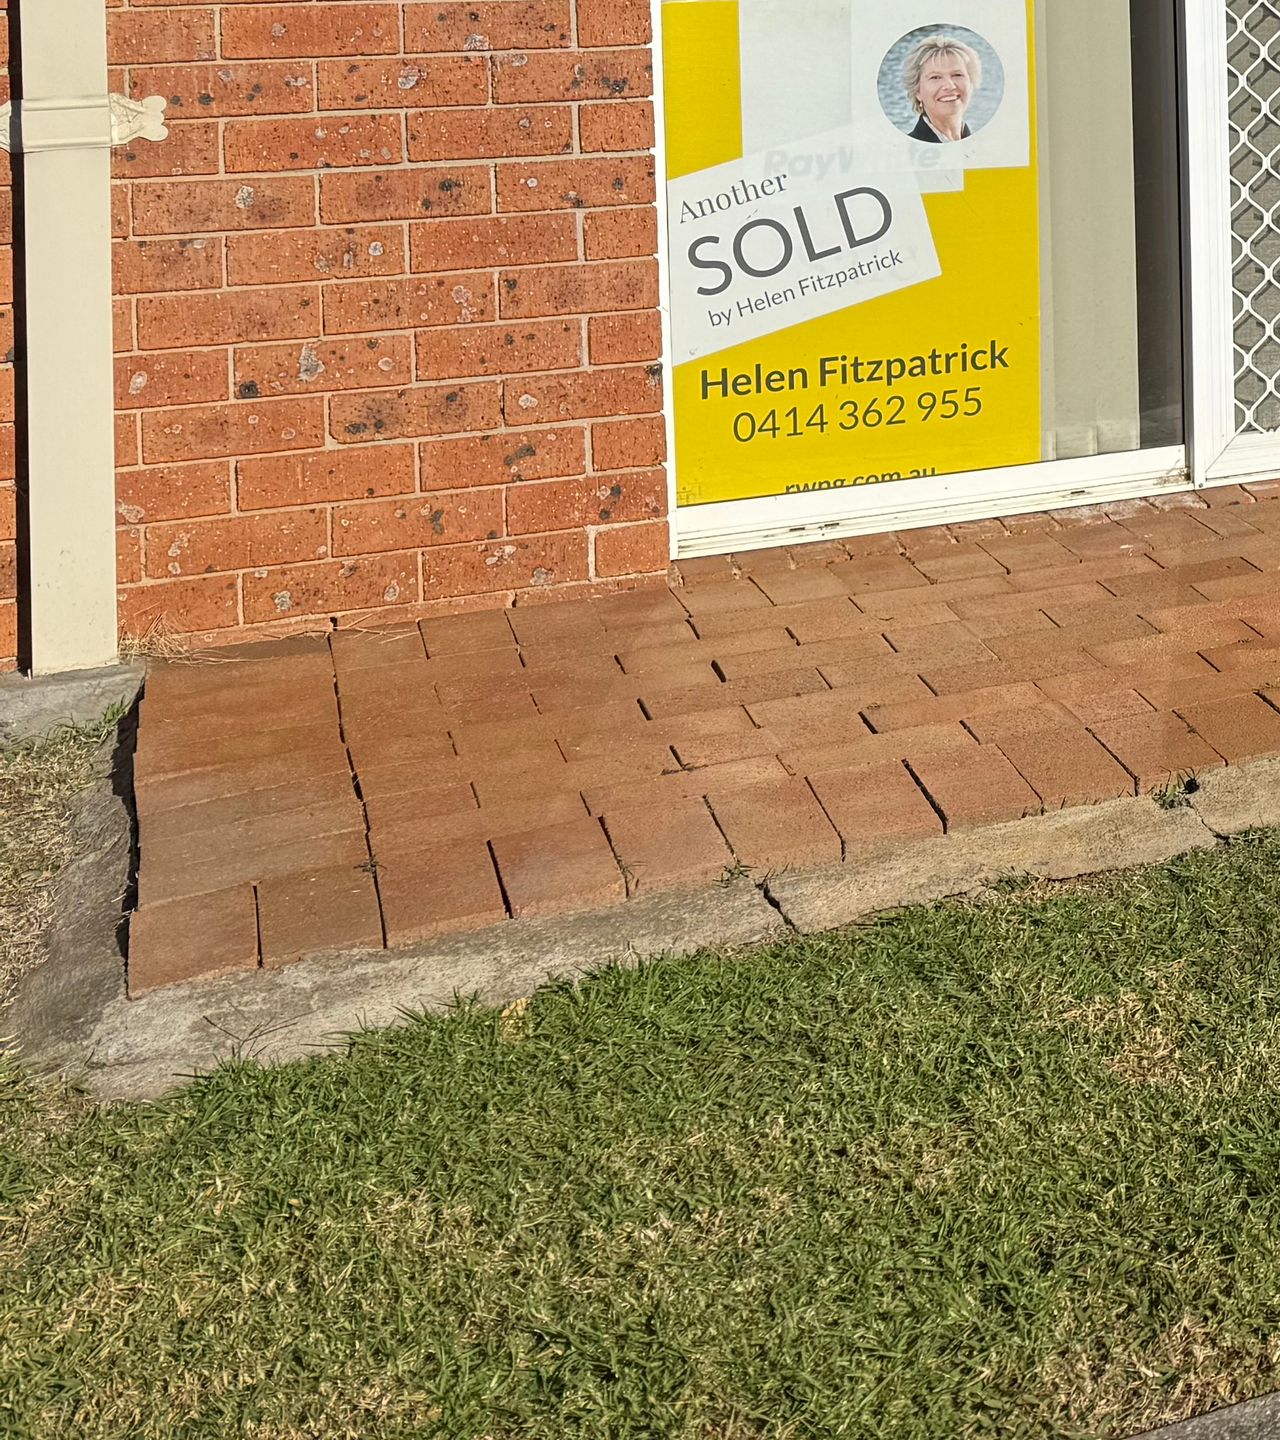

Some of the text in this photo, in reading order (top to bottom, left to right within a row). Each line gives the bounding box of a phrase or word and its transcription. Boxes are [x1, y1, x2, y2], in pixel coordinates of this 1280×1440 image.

[679, 173, 788, 224] Another
[687, 186, 893, 296] SOLD
[707, 308, 733, 327] by
[736, 286, 796, 317] Helen
[798, 250, 904, 296] Fitzpatrick
[700, 339, 1010, 400] Helen Fitzpatrick
[732, 386, 983, 443] 0414 362 955
